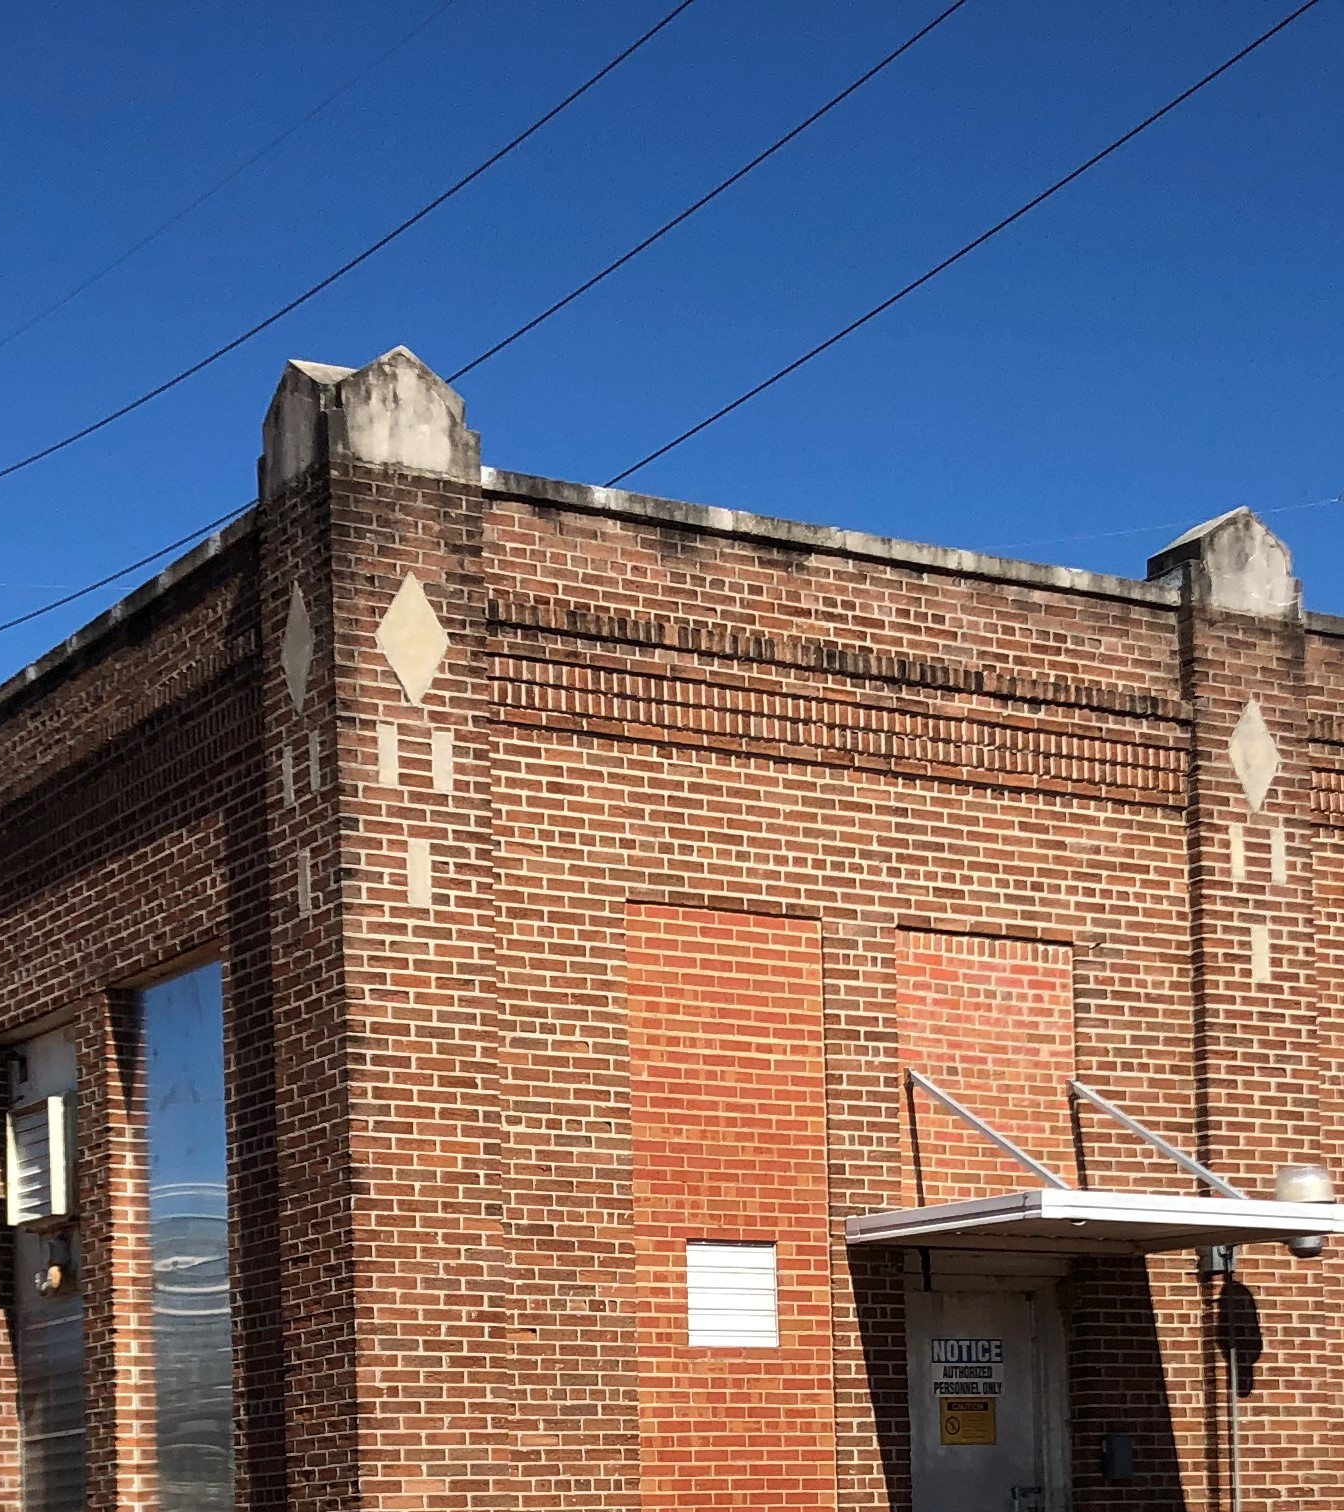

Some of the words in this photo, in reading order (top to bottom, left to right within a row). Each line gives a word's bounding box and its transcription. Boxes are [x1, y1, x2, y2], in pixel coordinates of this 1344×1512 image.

[932, 1340, 1002, 1362] NOTICE
[942, 1366, 993, 1379] AUTHORIZED
[933, 1382, 981, 1395] PERSONNEL
[982, 1382, 1002, 1395] ONLY
